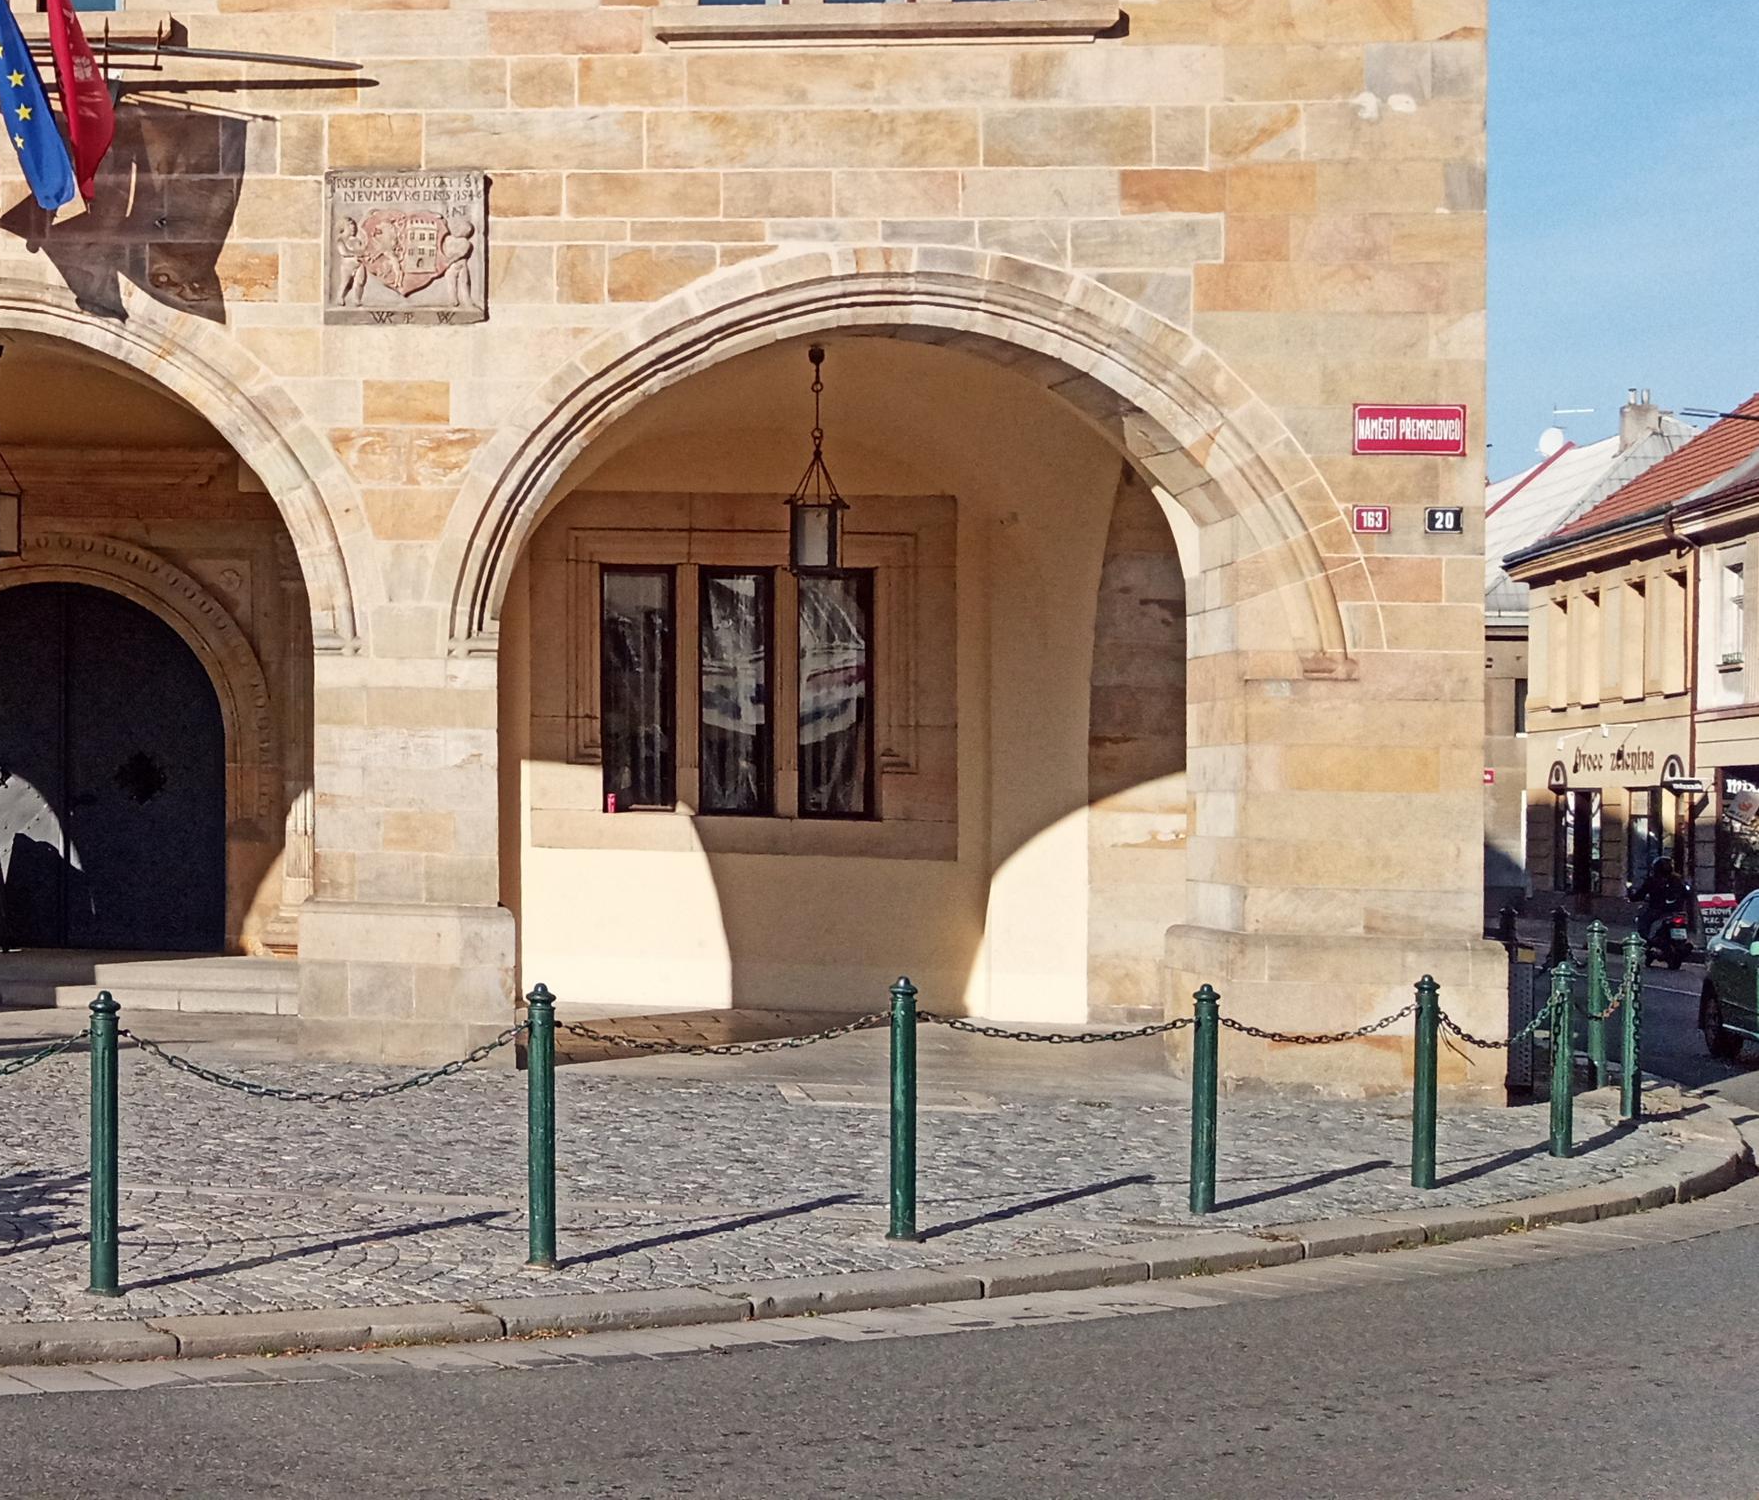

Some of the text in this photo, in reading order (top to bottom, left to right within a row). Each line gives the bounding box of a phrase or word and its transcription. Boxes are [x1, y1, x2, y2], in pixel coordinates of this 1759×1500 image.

[1358, 417, 1461, 441] NÁMĚSTÍ PŘEMYSLOVCŮ
[1361, 511, 1383, 528] 163
[1434, 511, 1455, 529] 20
